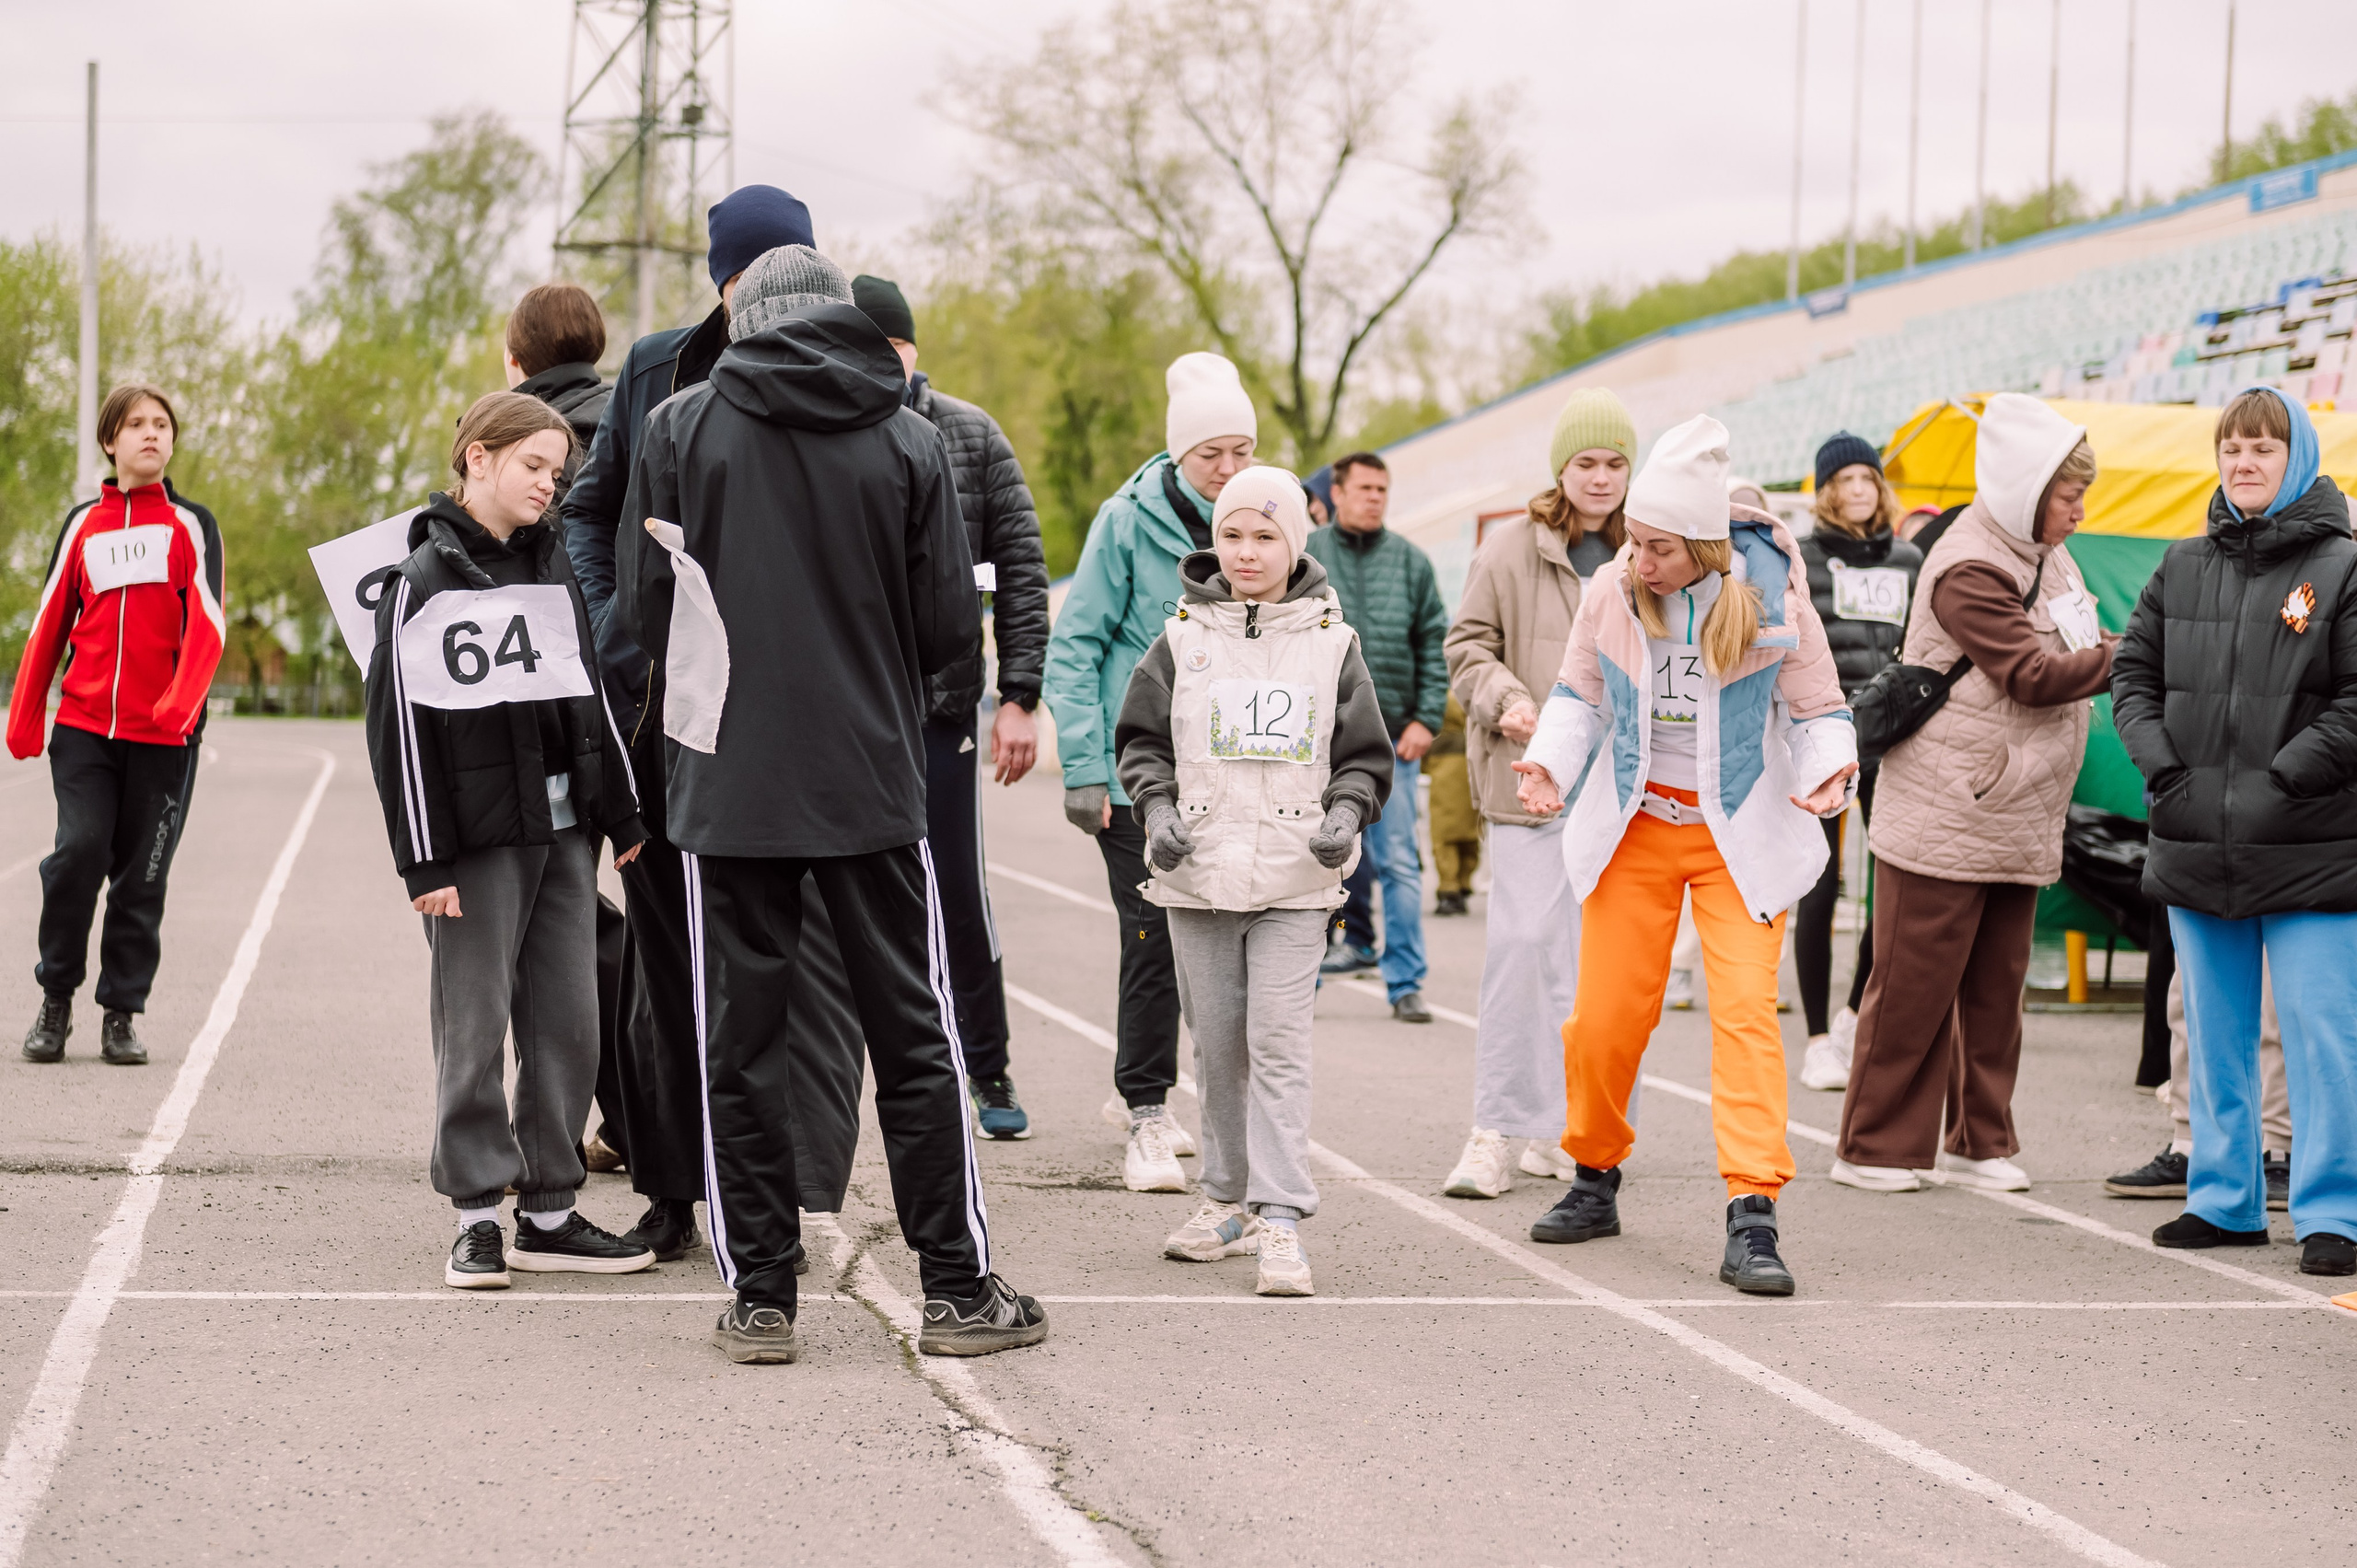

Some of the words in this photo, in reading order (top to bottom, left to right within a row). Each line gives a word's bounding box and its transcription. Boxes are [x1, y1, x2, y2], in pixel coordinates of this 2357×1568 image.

[110, 540, 146, 566] 110
[1859, 575, 1892, 608] 16
[442, 613, 543, 686] 64
[1656, 655, 1703, 703] 13
[1245, 689, 1292, 739] 12
[145, 819, 169, 883] JORDAN
